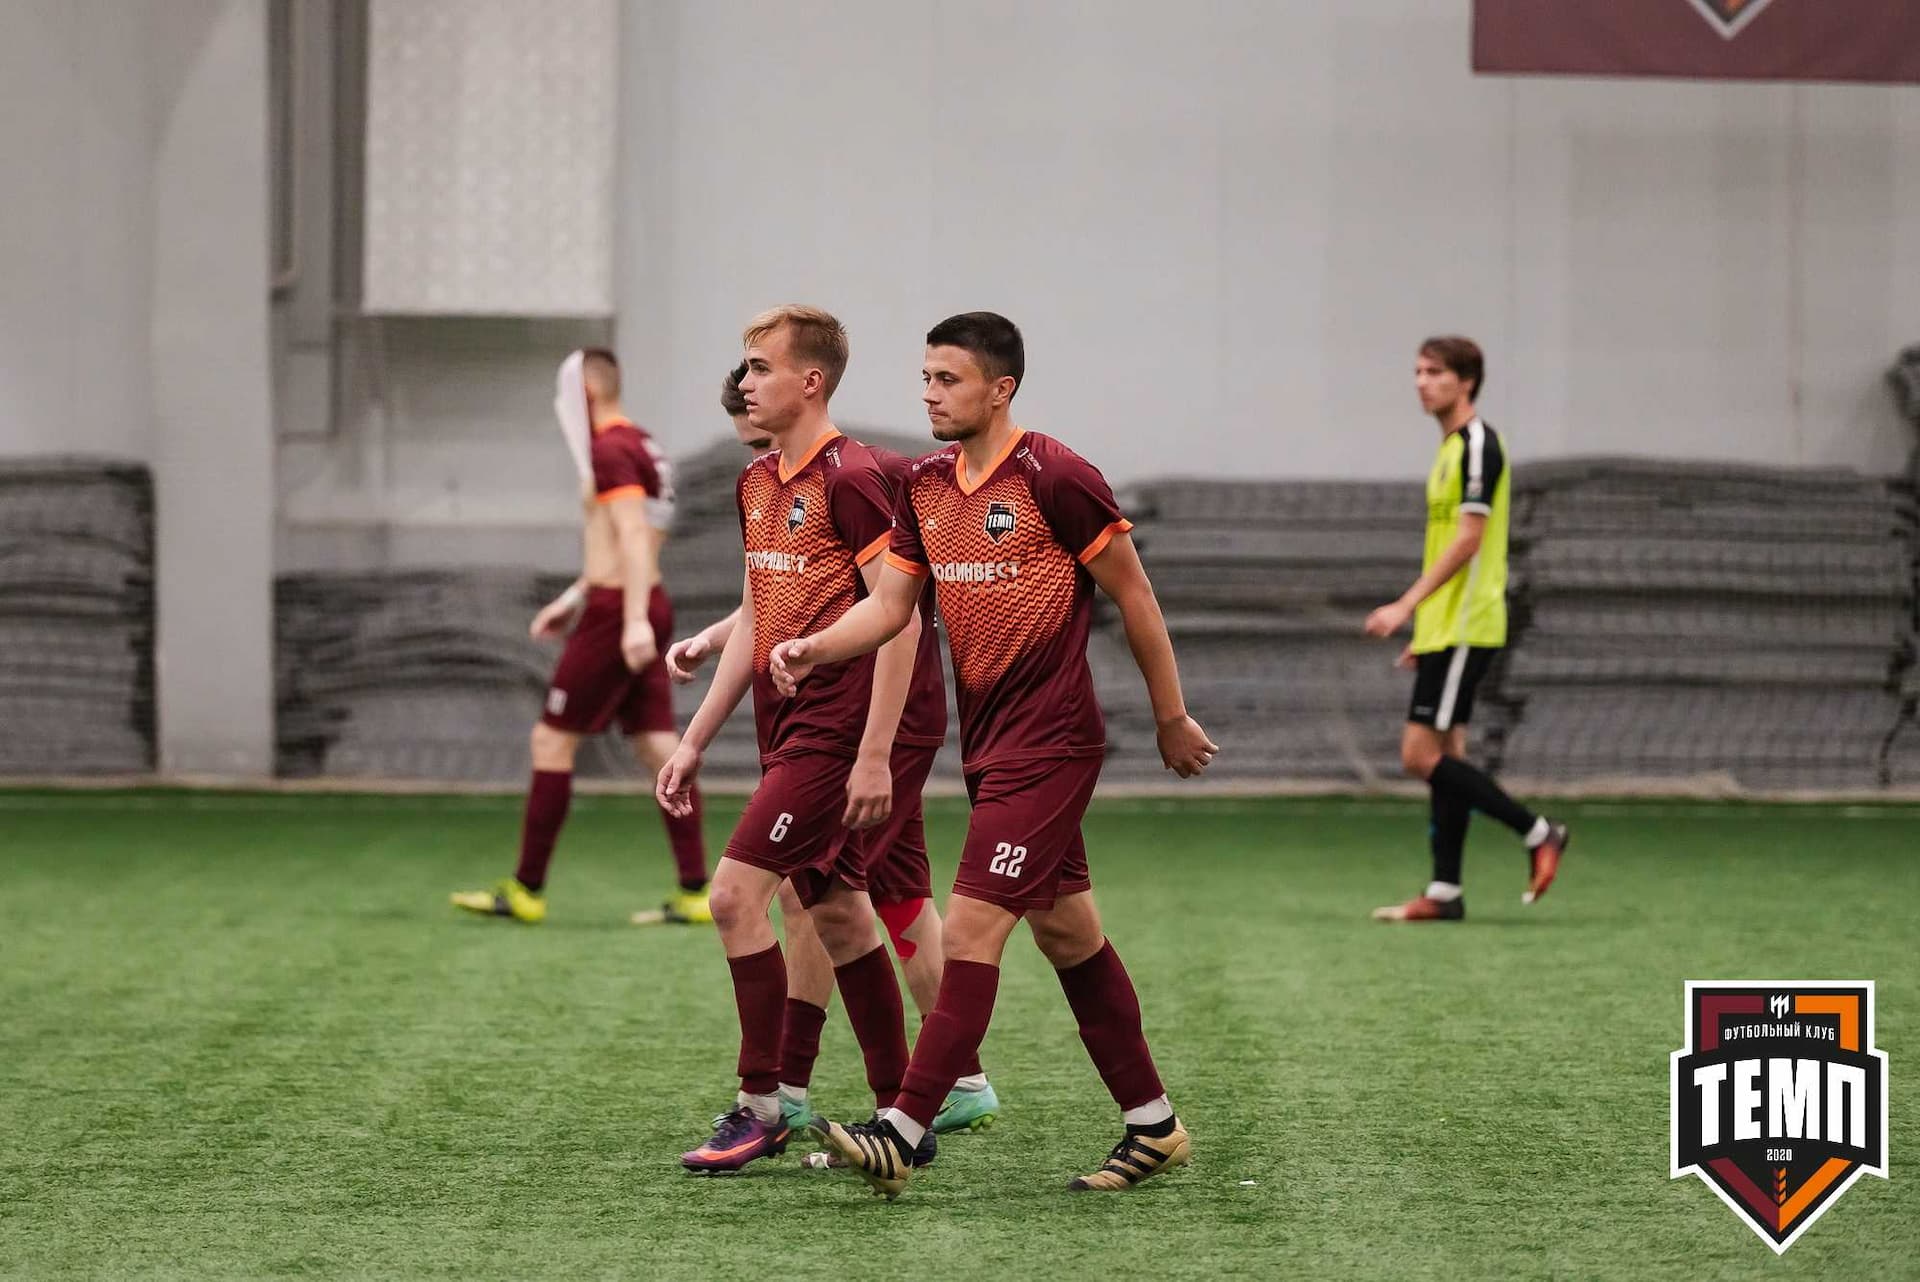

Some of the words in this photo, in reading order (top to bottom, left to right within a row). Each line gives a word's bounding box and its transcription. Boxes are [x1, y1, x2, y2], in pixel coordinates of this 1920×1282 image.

[987, 513, 1013, 529] ТЕМП
[768, 811, 794, 843] 6
[988, 842, 1028, 879] 22
